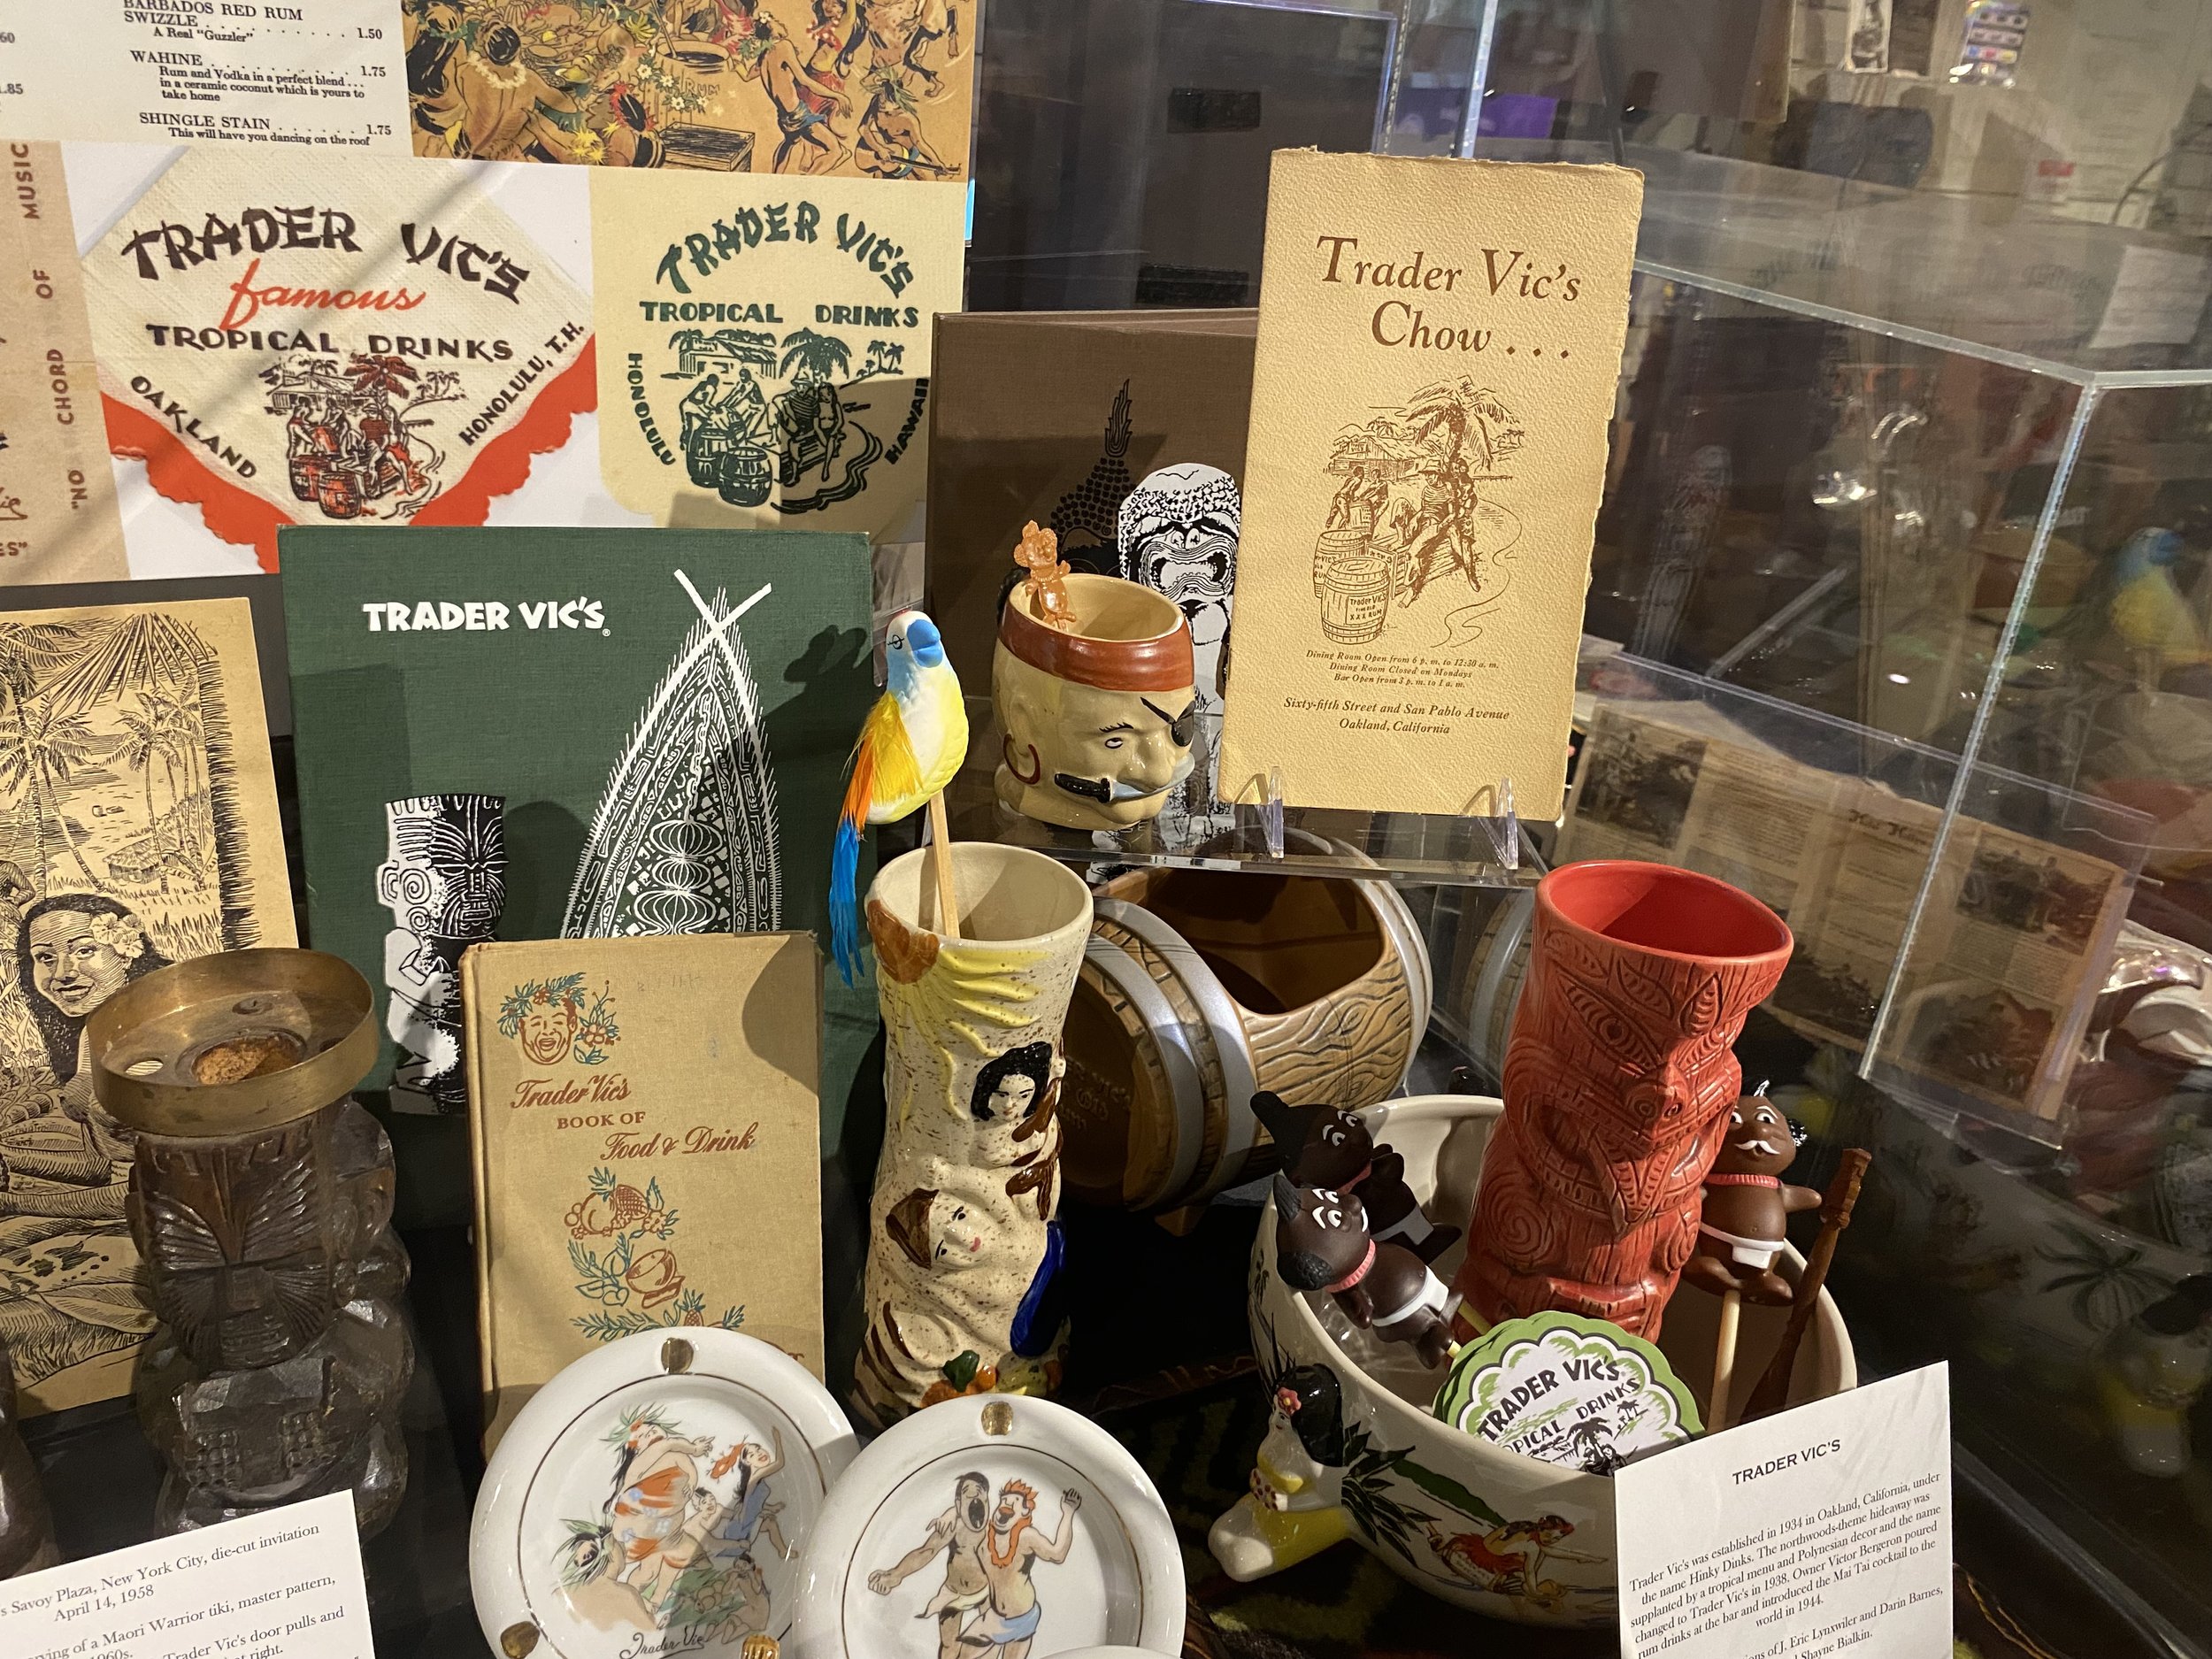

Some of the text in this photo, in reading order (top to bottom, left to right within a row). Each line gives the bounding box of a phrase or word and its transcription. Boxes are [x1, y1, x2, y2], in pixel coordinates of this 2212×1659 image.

[124, 0, 303, 20] BARBADOS RED RUM
[124, 11, 198, 27] SWIZZLE
[154, 27, 253, 42] A Real "Guzzler"
[357, 27, 382, 39] 1.50
[130, 50, 203, 66] WAHINE
[159, 65, 188, 77] Rum
[191, 68, 211, 79] and
[213, 69, 251, 81] Vodka
[252, 71, 265, 81] in
[275, 73, 313, 85] perfect
[315, 75, 345, 86] blend
[361, 65, 386, 77] 1.75
[159, 77, 172, 88] in
[184, 81, 227, 90] ceramic
[276, 85, 308, 95] which
[310, 86, 319, 96] is
[321, 89, 350, 98] yours
[162, 89, 220, 101] take home
[685, 77, 720, 98] RUM
[140, 112, 270, 129] SHINGLE STAIN
[168, 127, 194, 138] This
[196, 129, 217, 139] will
[218, 129, 245, 140] have
[247, 134, 268, 142] you
[270, 132, 311, 145] dancing
[329, 134, 347, 144] the
[349, 136, 370, 145] roof
[366, 124, 391, 135] 1.75
[11, 143, 40, 219] MUSIC
[122, 206, 531, 304] TRADER VIC'S
[656, 200, 914, 299] TRADER VIC'S
[33, 269, 54, 299] OF
[1317, 235, 1581, 301] Trader Vic's
[219, 257, 426, 330] famous
[639, 301, 919, 327] TROPICAL DRINKS
[1371, 300, 1492, 352] Chow
[146, 324, 514, 363] TROPICAL DRINKS
[47, 349, 74, 426] CHORD
[459, 321, 585, 447] HONOLULU, T.H.
[130, 374, 258, 480] OAKLAND
[627, 353, 677, 466] HONOLULU
[884, 378, 930, 465] HAWAII
[362, 601, 511, 632] TRADER
[1330, 663, 1357, 672] Dining
[1389, 665, 1417, 674] Closed
[1434, 669, 1471, 678] Mondays
[1284, 697, 1509, 719] Sixty-fifth Street and San Pablo Avenue
[1340, 718, 1449, 733] Oakland, California
[511, 1073, 632, 1109] Trader Vic's
[557, 1111, 646, 1130] BOOK OF
[600, 1121, 759, 1160] Food & Drink
[1477, 1369, 1559, 1442] TRADER
[1502, 1377, 1641, 1454] PICAL DRINKS
[1732, 1440, 1840, 1485] TRADER VIC'S
[1630, 1473, 1939, 1591] Trader Vic's was established in 1934 in Oakland, California, under
[1642, 1494, 1930, 1605] the name Hinky Dinks. The northwoods-theme hideaway was
[12, 1596, 51, 1613] Savoy
[57, 1586, 96, 1601] Plaza,
[101, 1575, 133, 1590] New
[136, 1562, 173, 1579] York
[177, 1555, 207, 1570] City,
[211, 1541, 257, 1560] die-cut
[260, 1526, 319, 1548] invitation
[1635, 1520, 1937, 1643] changed to Trader Vic's in 1938. Owner Victor Bergeron poured
[55, 1585, 154, 1621] April 14, 1958
[73, 1639, 87, 1653] of
[103, 1624, 144, 1646] Maori
[149, 1611, 204, 1632] Warrior
[209, 1601, 234, 1617] tiki,
[239, 1590, 281, 1609] master
[287, 1578, 334, 1598] pattern,
[1756, 1594, 1823, 1626] world in 1944.
[163, 1606, 343, 1659] Trader Vic's door pulls and
[1767, 1587, 1943, 1657] of J. Eric Lynxwiler and Darin Barnes,
[1801, 1630, 1872, 1659] Shayne Bialkin.
